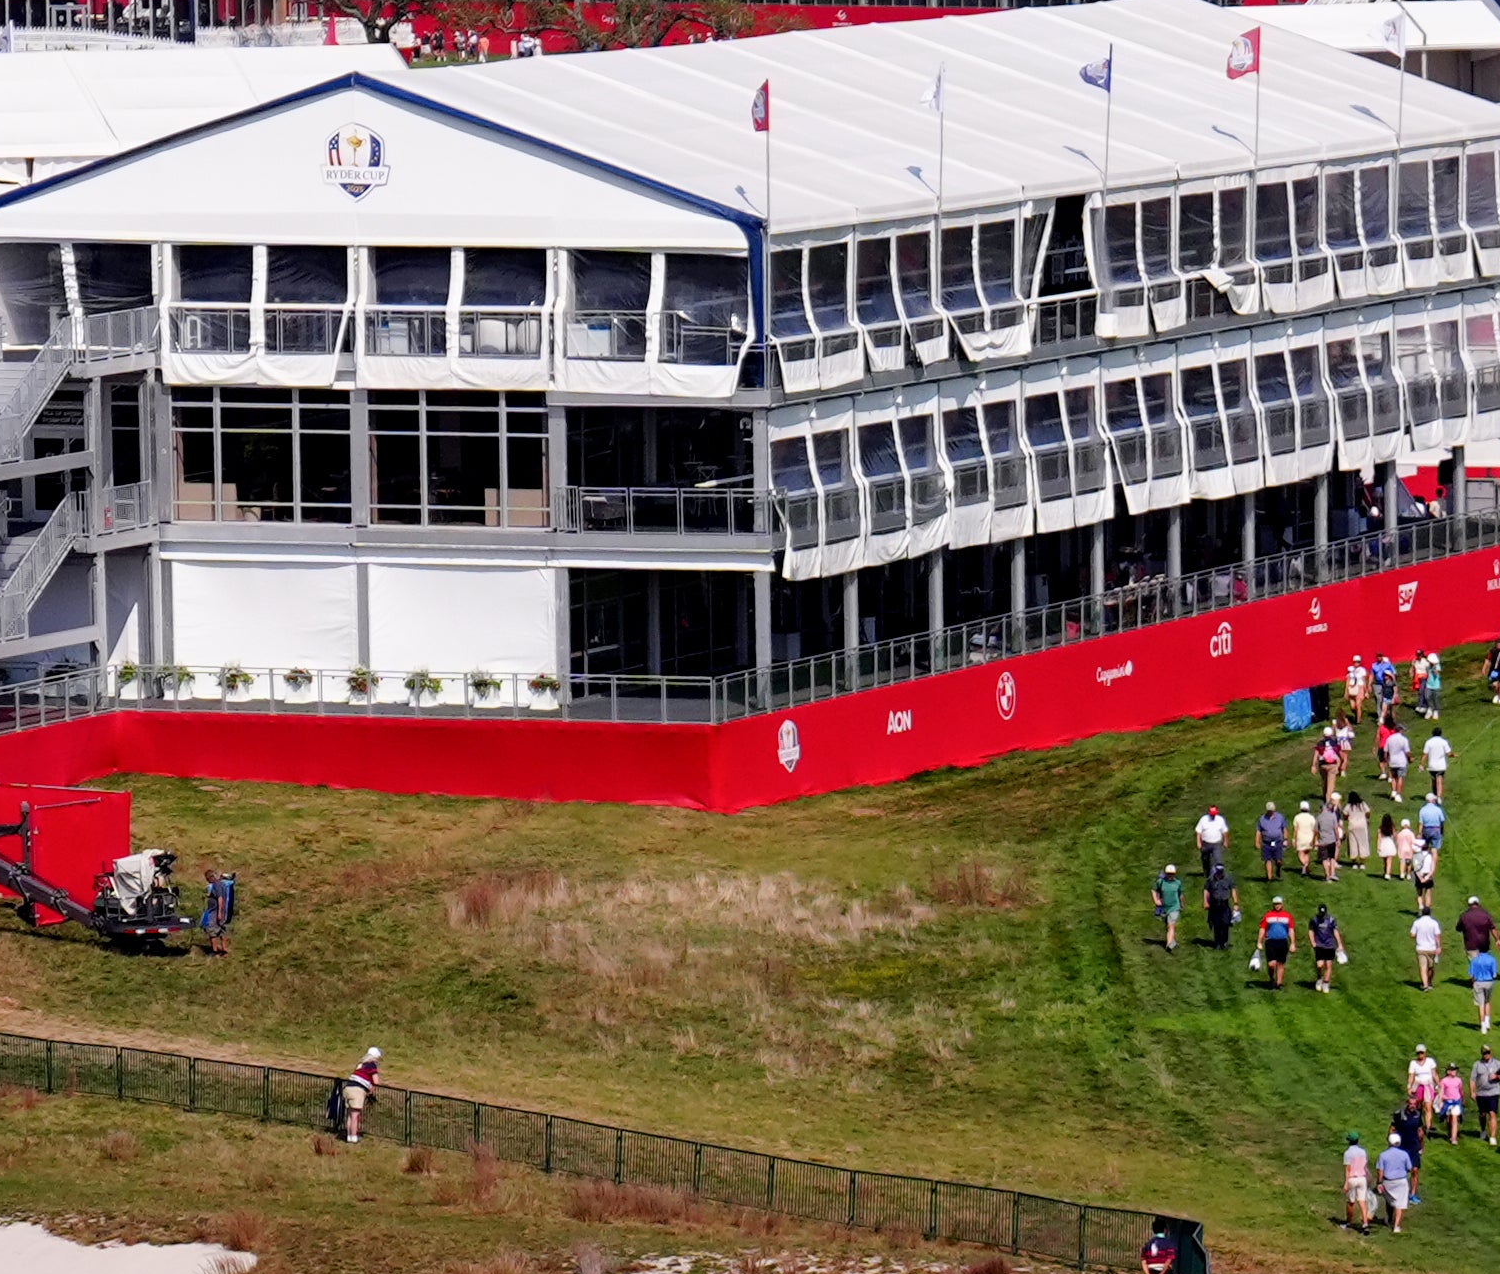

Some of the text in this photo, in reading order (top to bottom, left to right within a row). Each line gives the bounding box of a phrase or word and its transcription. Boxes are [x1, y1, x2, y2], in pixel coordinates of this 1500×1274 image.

[326, 169, 385, 181] RYDER CUP
[1209, 621, 1233, 659] citi
[886, 709, 913, 736] AON
